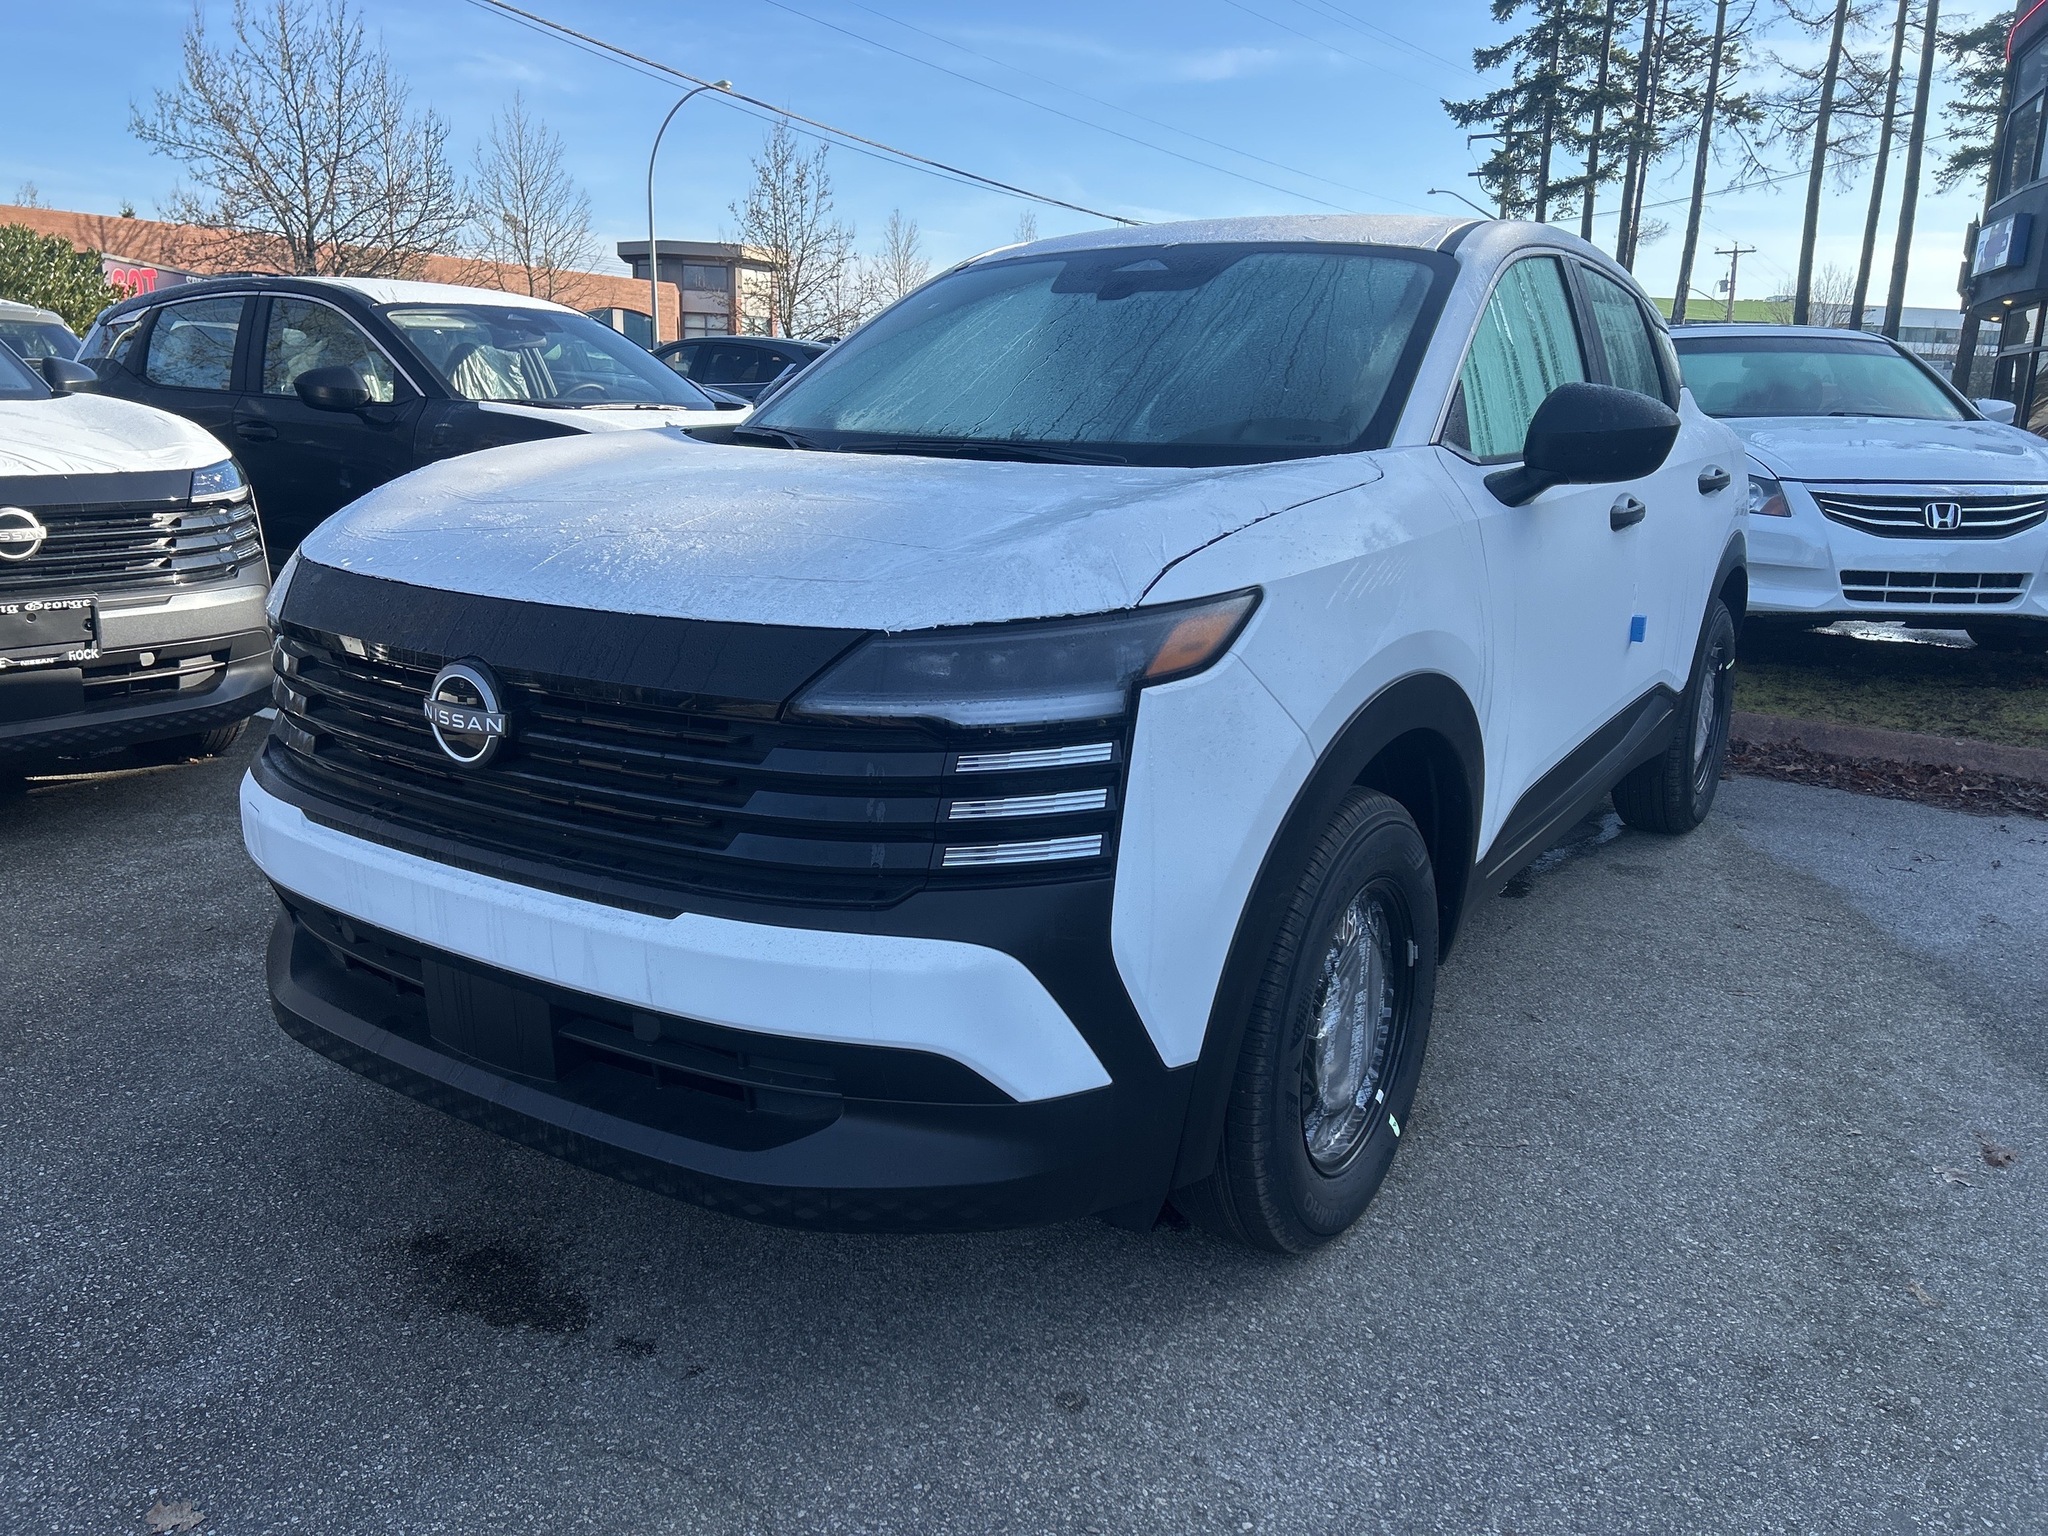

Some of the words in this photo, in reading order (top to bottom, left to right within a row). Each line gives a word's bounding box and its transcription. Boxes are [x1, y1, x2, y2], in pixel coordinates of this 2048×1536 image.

[24, 600, 91, 611] George
[20, 657, 54, 666] NISSAN
[68, 648, 100, 661] ROCK
[424, 703, 502, 733] NISSAN
